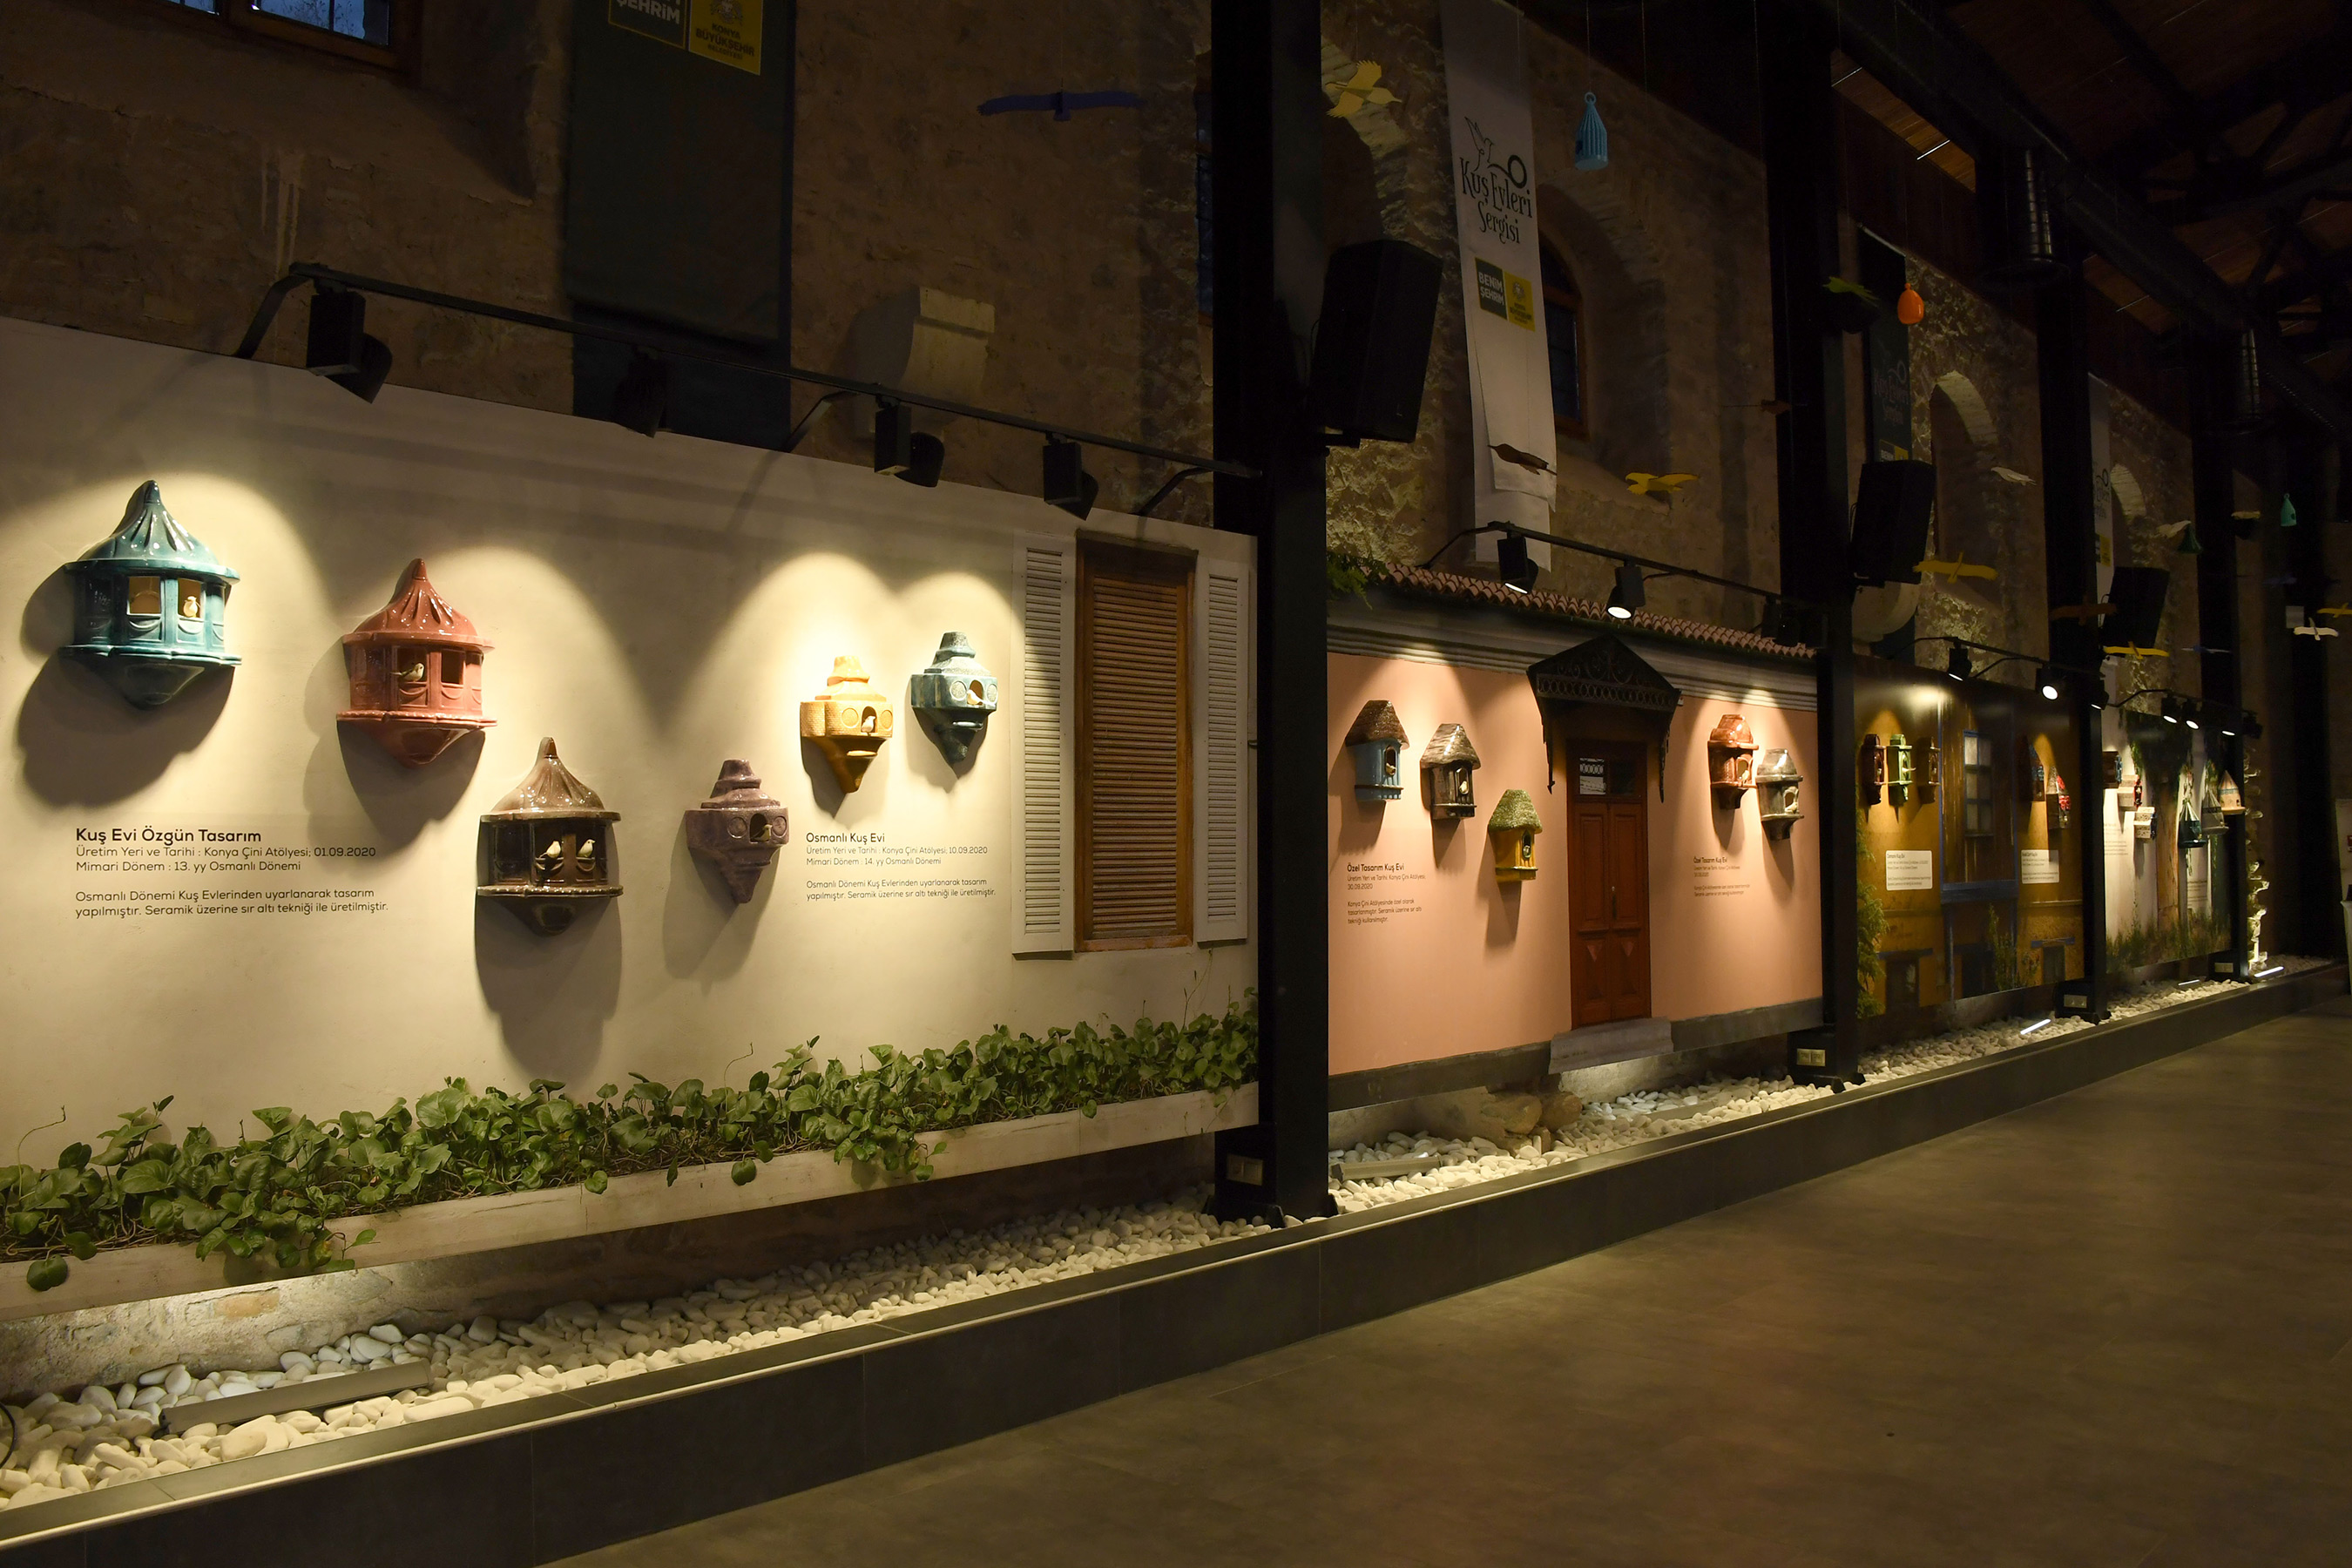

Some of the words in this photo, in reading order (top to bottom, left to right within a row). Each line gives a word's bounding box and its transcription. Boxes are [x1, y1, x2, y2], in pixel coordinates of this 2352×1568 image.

[712, 24, 740, 37] KONYA
[1460, 158, 1489, 205] Kuş
[1490, 172, 1532, 218] Evleri
[1478, 201, 1519, 244] Sergisi
[1478, 272, 1503, 293] BENİM
[76, 828, 106, 844] Kuş
[112, 828, 137, 841] Evi
[142, 826, 193, 846] Özgün
[199, 829, 261, 842] Tasarım
[806, 833, 847, 842] Osmanlı
[850, 833, 867, 845] Kuş
[871, 833, 885, 842] Evi
[77, 845, 117, 857] Üretim
[121, 847, 143, 857] Yeri
[146, 848, 160, 857] ve
[164, 847, 194, 857] Tarihi
[205, 847, 239, 860] Konya
[242, 847, 262, 860] Çini
[265, 847, 311, 860] Atölyesi;
[314, 847, 375, 857] 01.09.2020
[807, 845, 831, 854] Üretim
[906, 847, 918, 855] Çini
[77, 862, 118, 871] Mimari
[123, 862, 165, 871] Dönem
[174, 862, 190, 871] 13.
[194, 864, 206, 874] yy
[210, 862, 255, 871] Osmanlı
[260, 862, 301, 870] Dönemi
[1348, 862, 1360, 872] Özel
[868, 880, 880, 889] Kuş
[920, 879, 960, 888] uyarlanarak
[76, 891, 125, 902] Osmanlı
[130, 890, 174, 901] Dönemi
[179, 890, 199, 902] Kuş
[202, 889, 261, 900] Evlerinden
[265, 889, 330, 901] uyarlanarak
[334, 889, 374, 898] tasarım
[807, 892, 845, 902] yapılmıştır.
[928, 890, 949, 899] tekniği
[960, 889, 996, 897] üretilmiştir.
[76, 906, 141, 918] yapılmıştır.
[145, 904, 193, 915] Seramik
[197, 904, 237, 914] üzerine
[241, 905, 253, 914] sır
[258, 903, 274, 913] altı
[278, 902, 312, 915] tekniği
[315, 902, 328, 912] ile
[331, 902, 388, 914] üretilmiştir.
